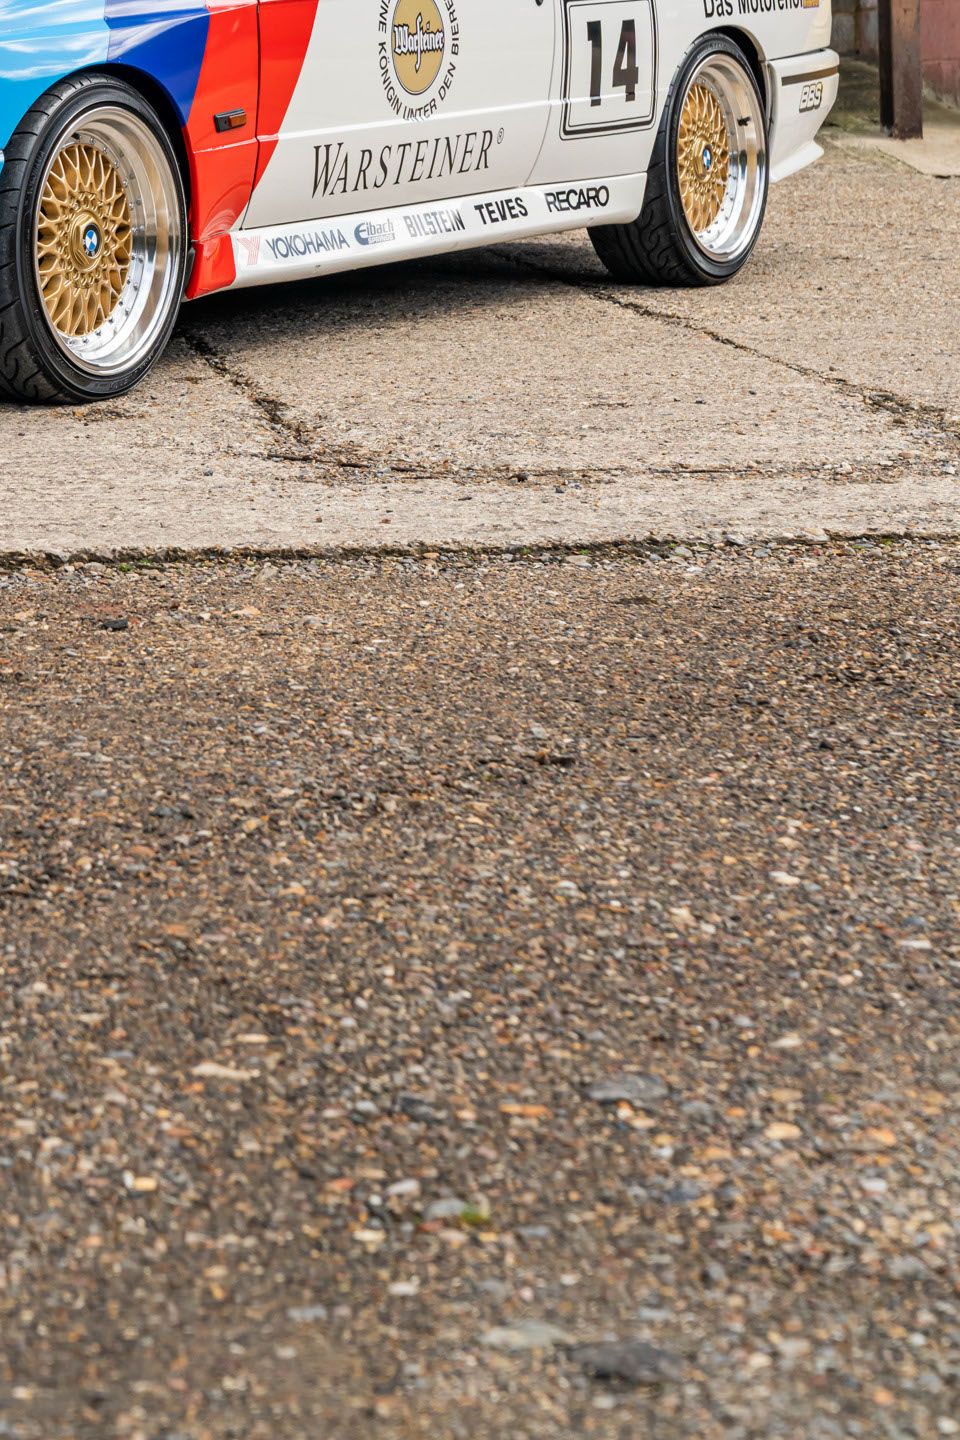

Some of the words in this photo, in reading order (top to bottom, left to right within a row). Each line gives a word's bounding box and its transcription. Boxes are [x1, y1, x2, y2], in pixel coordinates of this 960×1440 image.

[586, 18, 639, 107] 14
[378, 41, 403, 116] KÖNIGIN
[439, 61, 457, 101] DEN
[798, 81, 824, 113] BBS
[474, 196, 529, 225] TEVES
[544, 185, 610, 213] RECARO
[353, 218, 394, 246] Eibach
[403, 208, 466, 238] BILSTEIN
[266, 228, 351, 259] YOKOHAMA
